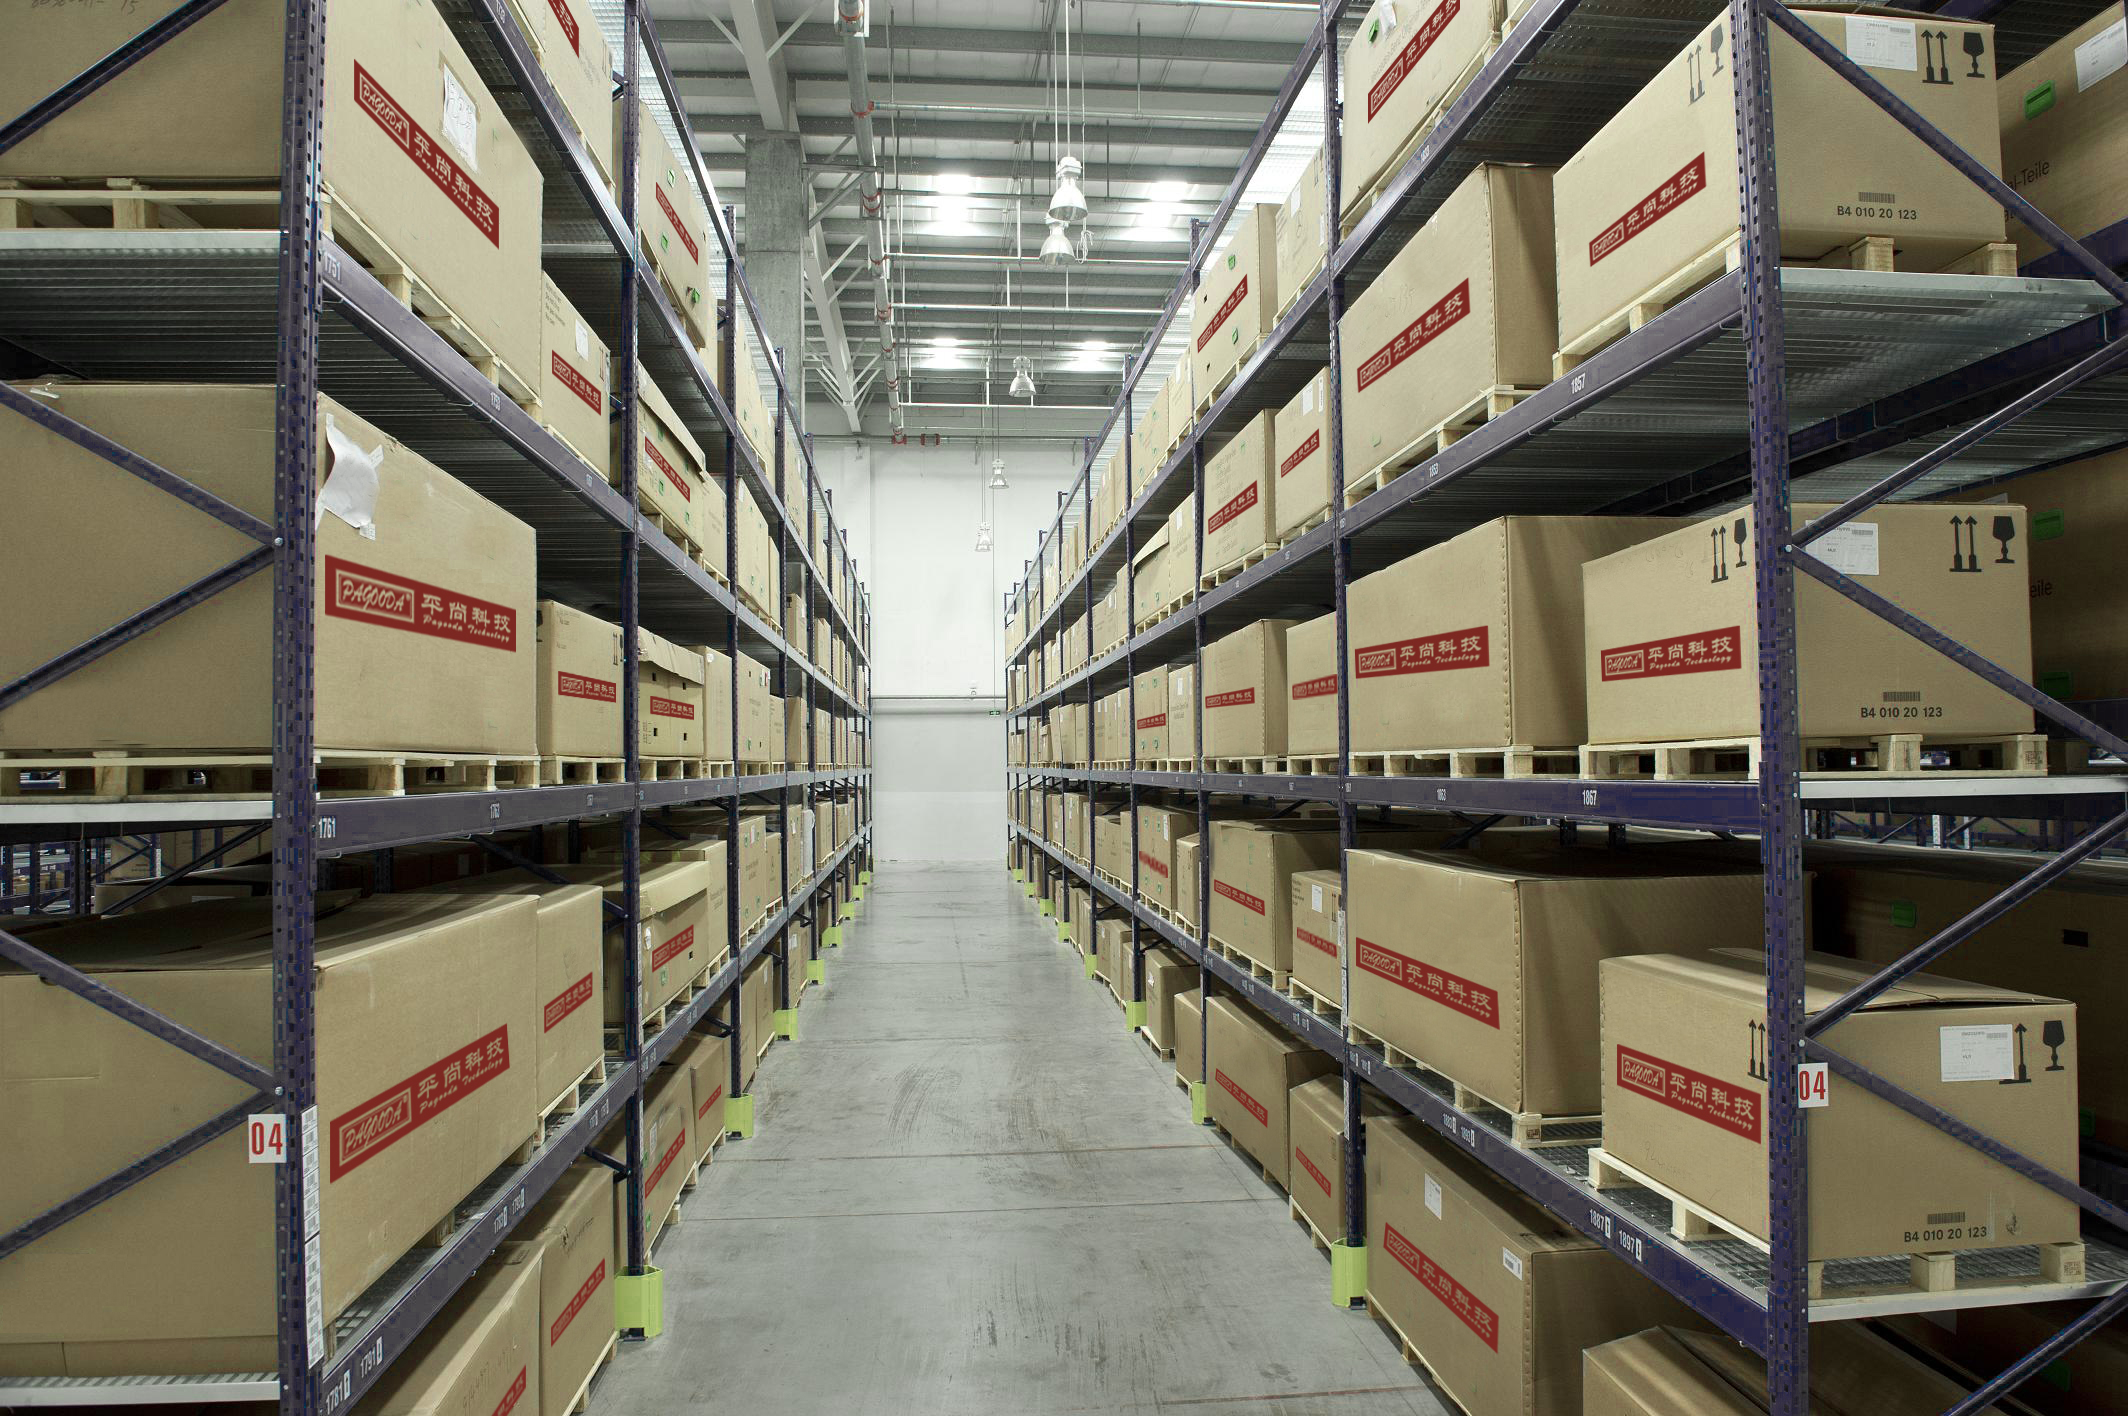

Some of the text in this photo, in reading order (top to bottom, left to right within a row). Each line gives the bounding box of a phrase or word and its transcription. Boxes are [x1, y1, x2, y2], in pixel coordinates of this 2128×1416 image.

[414, 131, 494, 225] 平尚科技
[2003, 160, 2050, 190] al-Teile
[1626, 165, 1699, 227] 平尚科技
[1837, 205, 1917, 220] B4 010 20 123
[1393, 291, 1463, 353] 平尚科技
[1571, 372, 1586, 394] 1857
[342, 580, 404, 612] PAGOODA
[420, 593, 511, 633] 平尚科技
[423, 614, 510, 643] Pagooda Technology
[1400, 636, 1482, 660] 平尚科技
[1648, 636, 1733, 662] 平尚科技
[1861, 707, 1942, 718] B4 010 20 123
[1582, 789, 1597, 806] 1867
[319, 817, 336, 838] 1761
[1406, 963, 1492, 1010] 平尚科技
[417, 1037, 504, 1099] 平尚科技
[419, 1058, 503, 1114] Pagooda Technology
[1669, 1072, 1755, 1120] 平尚科技
[1799, 1070, 1826, 1100] 04
[1671, 1091, 1753, 1131] Pagooda Technology
[252, 1122, 283, 1155] 04
[345, 1102, 402, 1154] PAGOODA
[1589, 1208, 1605, 1231] 1887
[1904, 1226, 1987, 1242] B4 010 20 123
[1618, 1230, 1635, 1254] 1897
[360, 1350, 377, 1380] 1791
[326, 1381, 343, 1415] 1781
